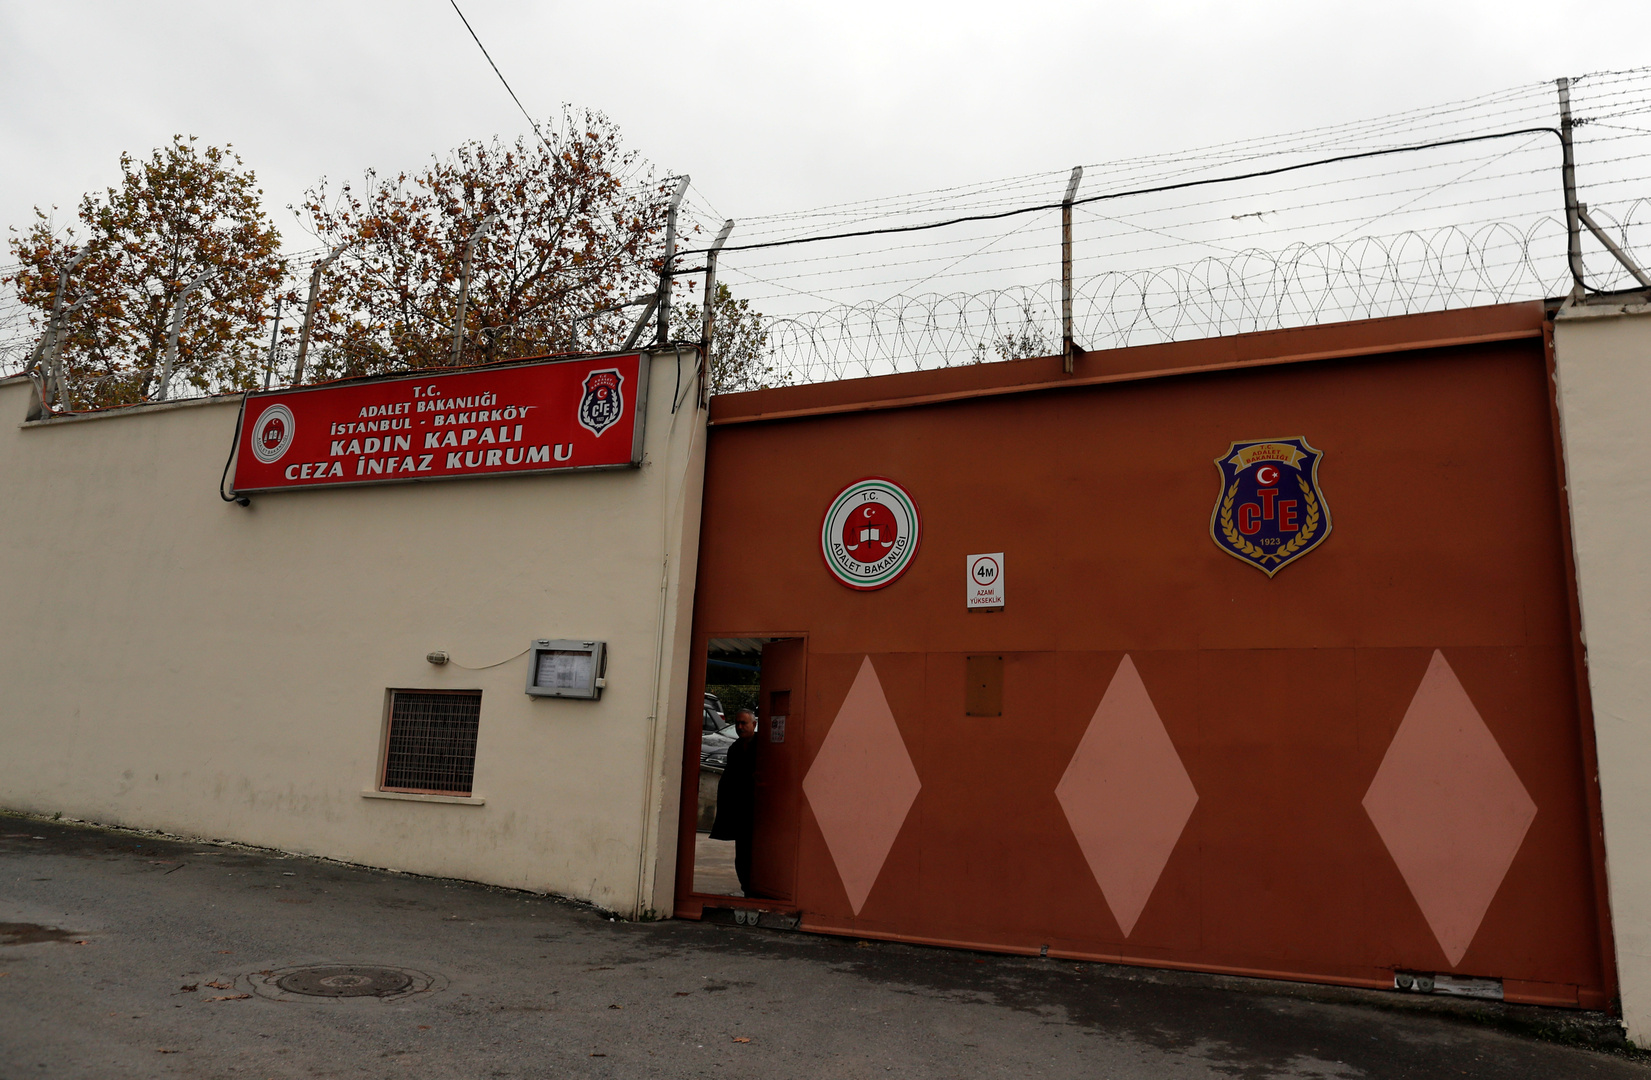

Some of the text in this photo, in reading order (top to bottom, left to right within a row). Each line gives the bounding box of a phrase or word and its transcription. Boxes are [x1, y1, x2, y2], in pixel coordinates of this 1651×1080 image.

[413, 384, 441, 398] T.C.
[358, 391, 497, 418] ADALET BAKANLIĞI
[330, 418, 412, 436] İSTANBUL
[433, 405, 529, 427] BAKIRKÖY
[329, 424, 523, 457] KADIN KAPALI
[1246, 454, 1289, 464] BAKANLIĞI
[1252, 449, 1281, 457] ADALET
[284, 443, 574, 480] CEZA İNFAZ KURUMU
[862, 491, 878, 501] T.C.
[1238, 488, 1299, 535] CTE
[1260, 537, 1281, 546] 1923
[833, 536, 907, 574] ADALET BAKANLIĞI
[977, 588, 995, 596] AZAMİ
[970, 595, 1002, 605] YÜKSEKLİK
